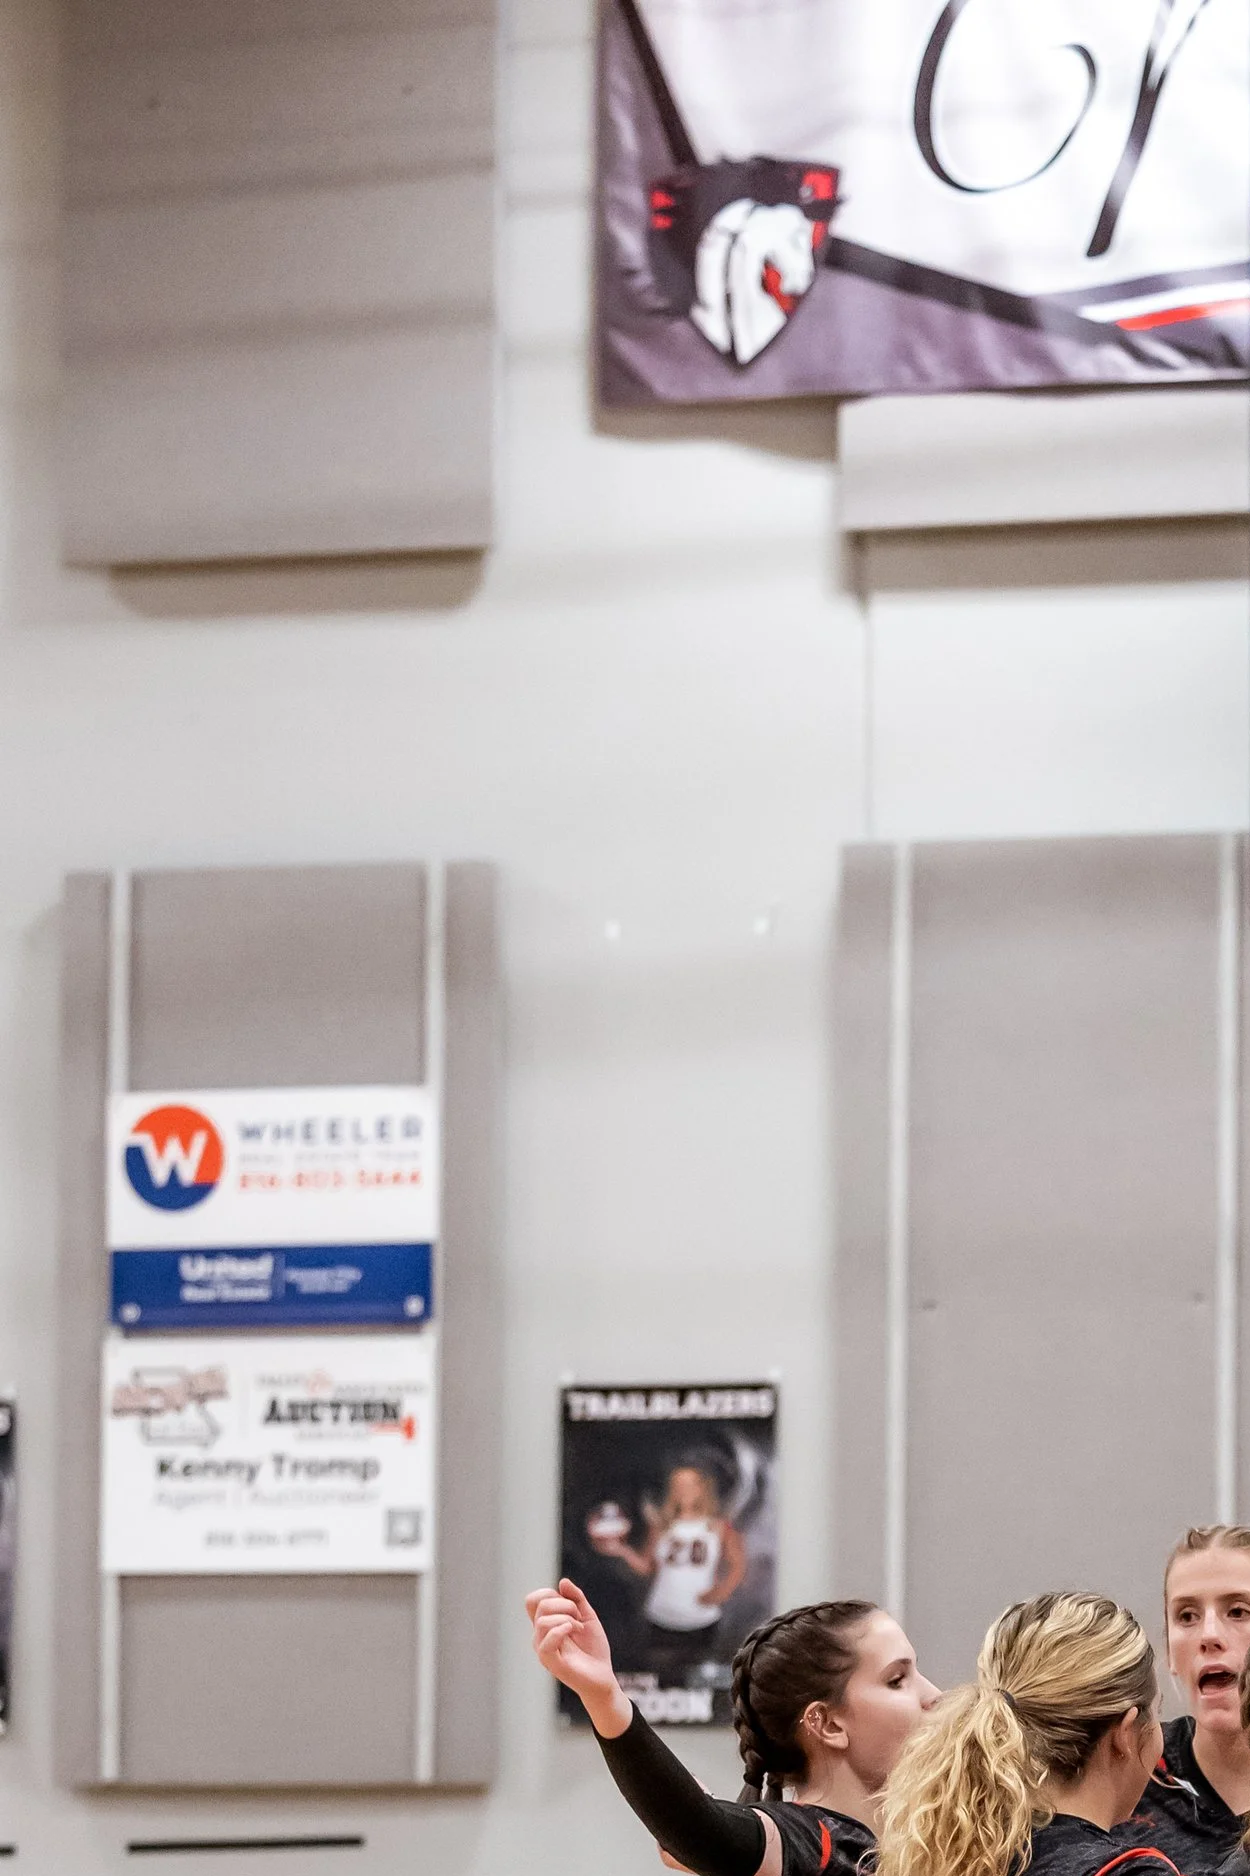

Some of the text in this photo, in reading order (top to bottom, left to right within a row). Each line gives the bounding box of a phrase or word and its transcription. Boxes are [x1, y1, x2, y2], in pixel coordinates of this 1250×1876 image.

[239, 1115, 422, 1145] WHEELER
[156, 1453, 380, 1482] Kenny Tromp
